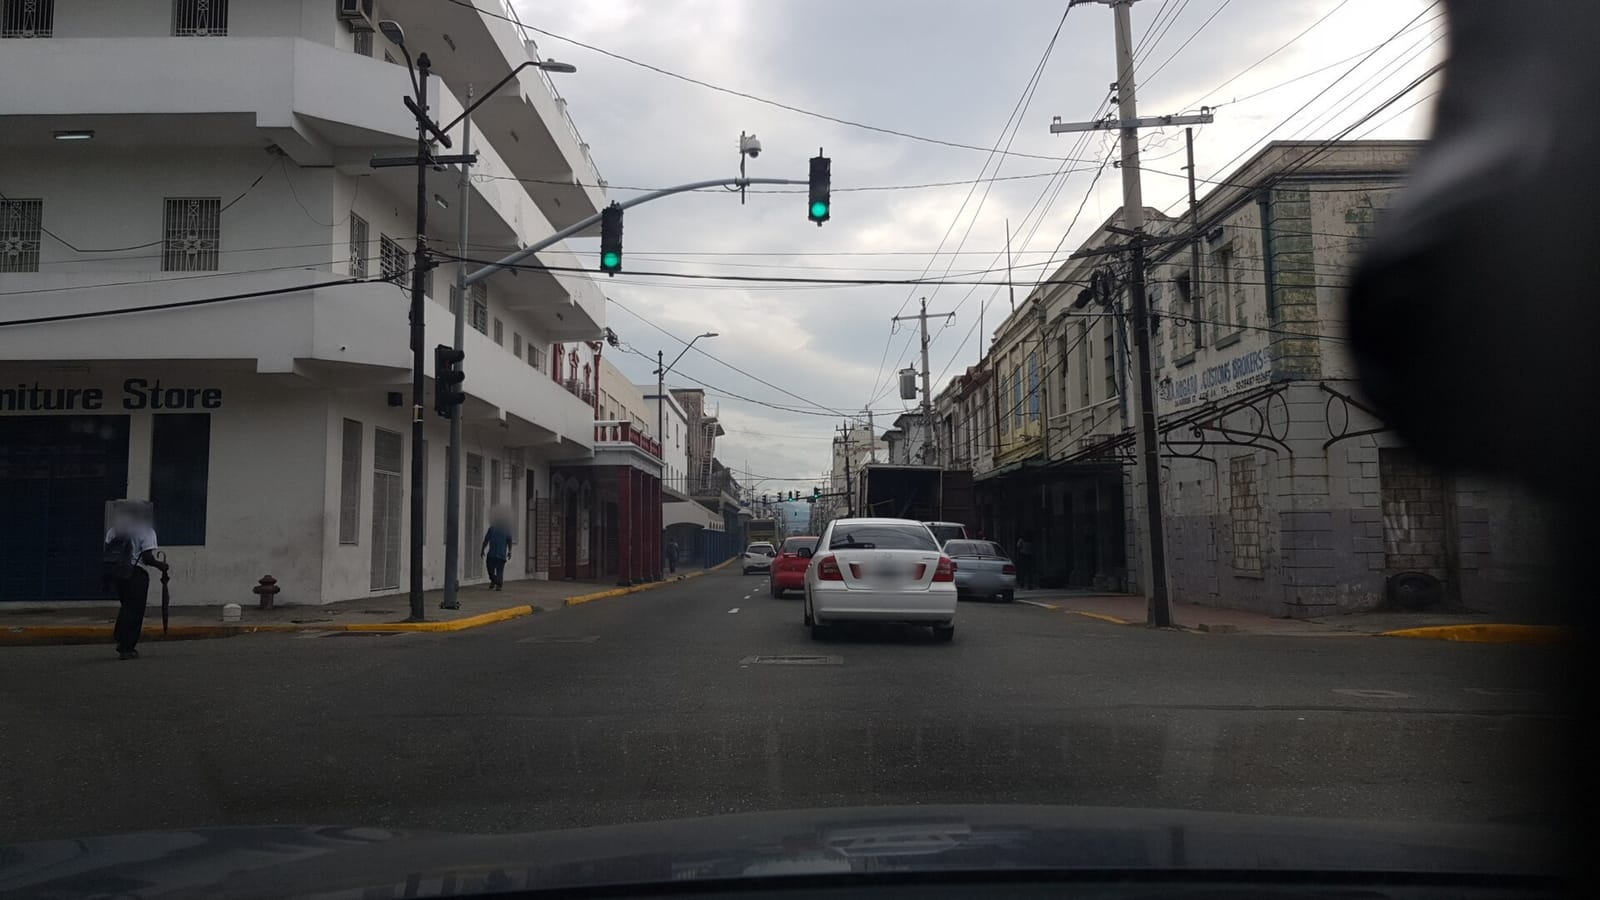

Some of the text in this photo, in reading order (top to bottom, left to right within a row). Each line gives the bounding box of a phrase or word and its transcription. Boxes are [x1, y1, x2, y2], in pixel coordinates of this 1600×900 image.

[1232, 350, 1264, 379] BROKERS
[0, 378, 222, 410] niture Store
